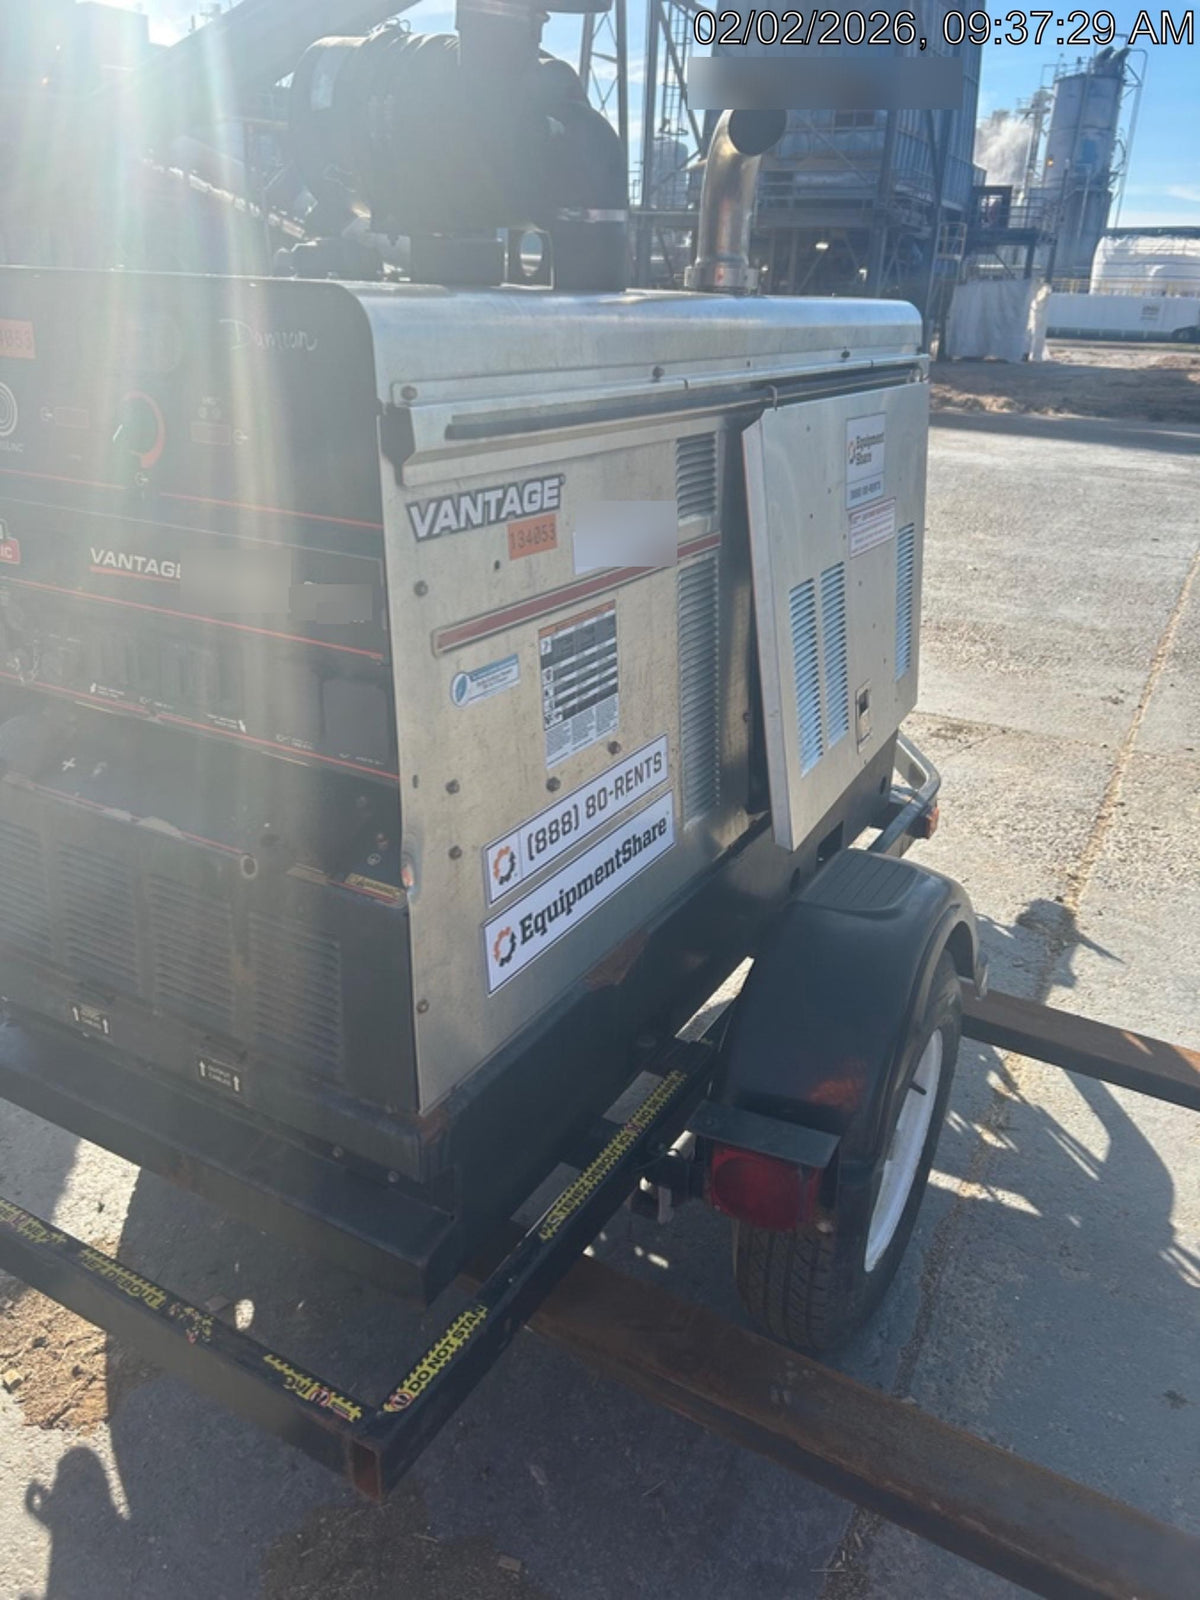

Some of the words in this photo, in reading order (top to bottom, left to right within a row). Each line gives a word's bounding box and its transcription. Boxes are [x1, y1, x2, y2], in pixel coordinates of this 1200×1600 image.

[408, 475, 562, 541] VANTAGE
[527, 804, 580, 861] (888)
[586, 751, 662, 819] 80-RENTS
[518, 817, 667, 945] EquipmentShare
[408, 1369, 431, 1393] DO
[427, 1340, 454, 1370] NOT
